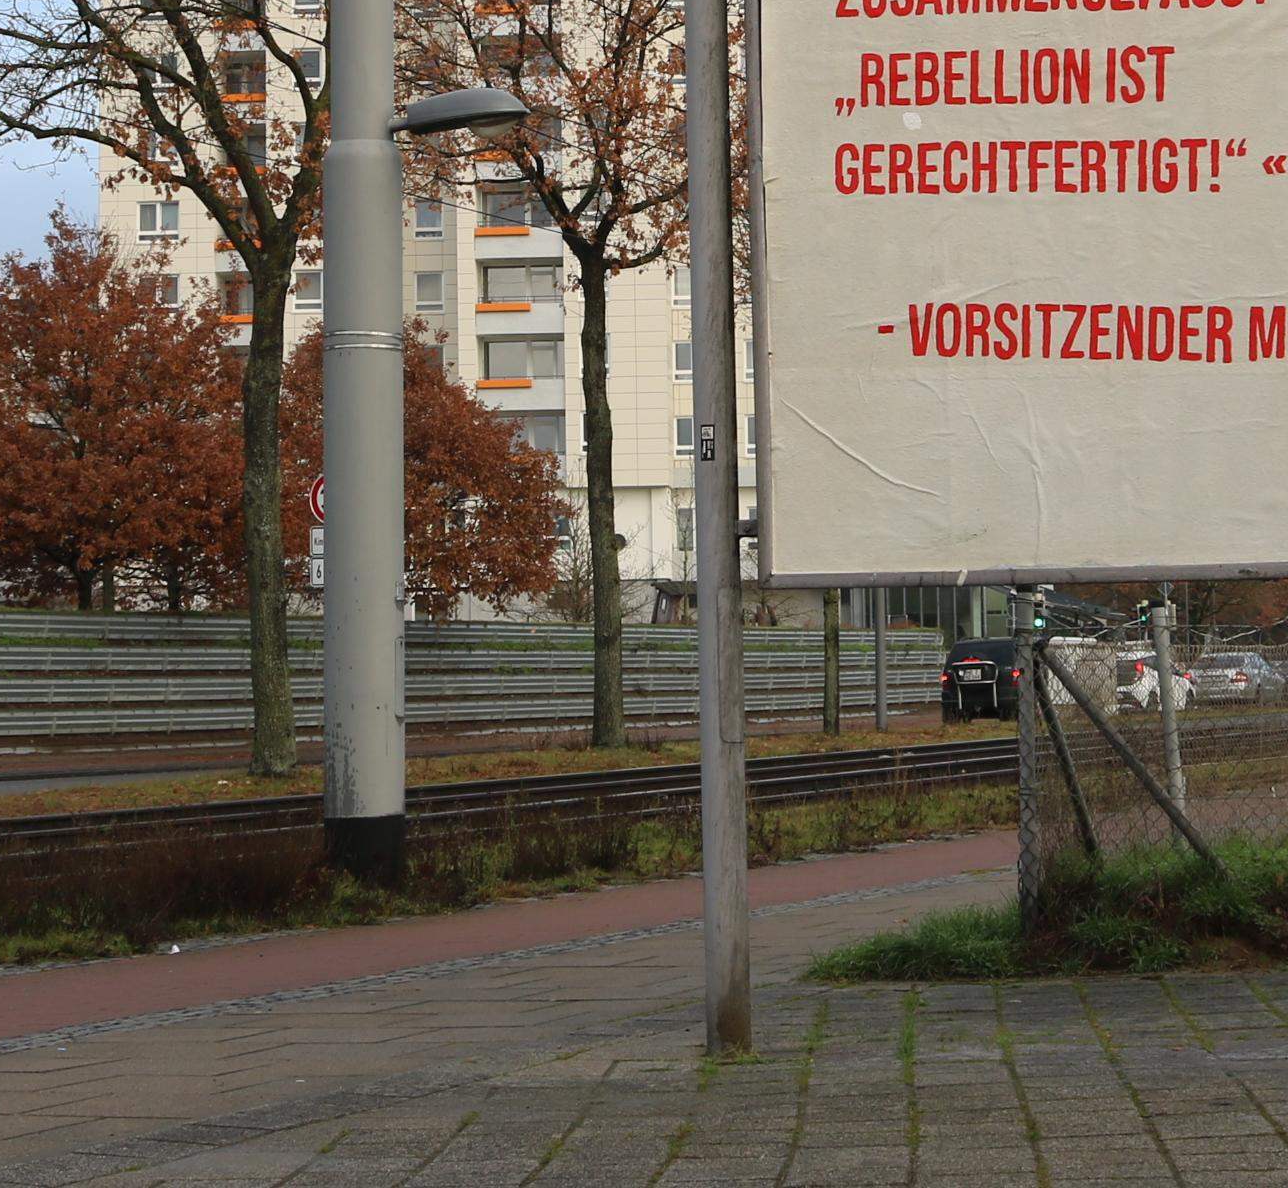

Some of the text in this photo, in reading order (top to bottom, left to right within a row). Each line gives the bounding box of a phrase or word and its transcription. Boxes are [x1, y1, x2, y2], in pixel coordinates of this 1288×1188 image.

[834, 44, 1177, 115] „REBELLION IST
[834, 137, 1248, 196] GERECHTFERTIGT!“
[908, 301, 1235, 365] VORSITZENDER
